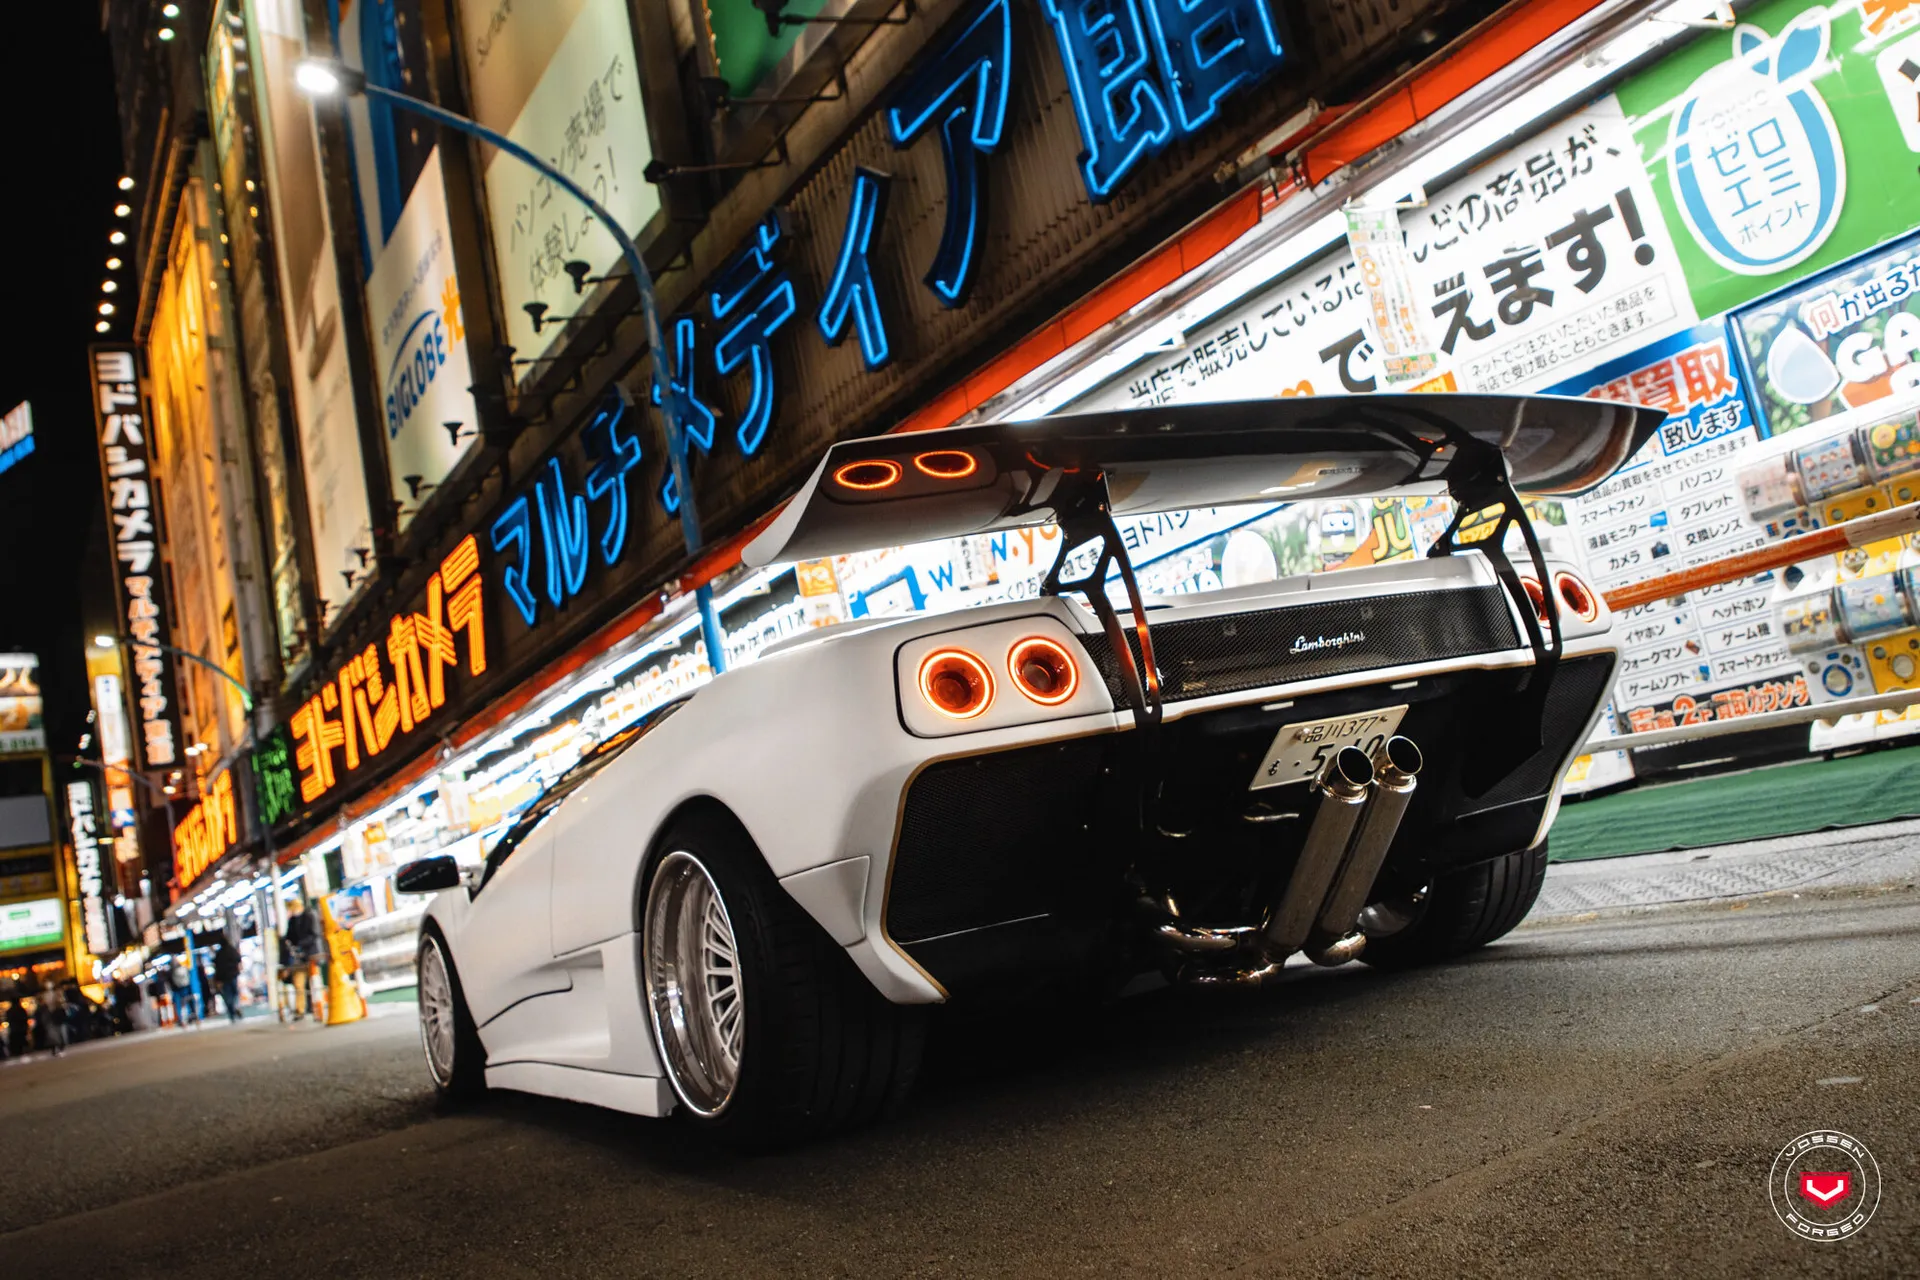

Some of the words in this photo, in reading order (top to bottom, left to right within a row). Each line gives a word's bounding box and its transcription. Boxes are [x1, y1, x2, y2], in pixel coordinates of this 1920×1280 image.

[1707, 117, 1786, 177] ゼロ
[1724, 157, 1801, 217] エミ
[1738, 200, 1810, 245] ポイント
[386, 316, 446, 440] BIGLOBE
[441, 274, 466, 353] 光
[1663, 403, 1742, 450] 致します
[95, 350, 153, 572] ヨドバシカメラ
[1580, 495, 1645, 525] スマートフォン
[1680, 468, 1723, 492] パソコン
[1588, 521, 1648, 549] 液晶モニター
[1681, 494, 1733, 519] タブレット
[1609, 550, 1641, 571] カメラ
[1686, 517, 1744, 546] 交換レンズ
[1625, 623, 1666, 644] イヤホン
[1722, 622, 1771, 646] ゲーム機
[1712, 596, 1767, 619] ヘッドホン
[289, 533, 487, 804] ヨドバシカメラ
[1289, 630, 1366, 654] Lamborghini
[1629, 674, 1691, 697] ゲームソフト
